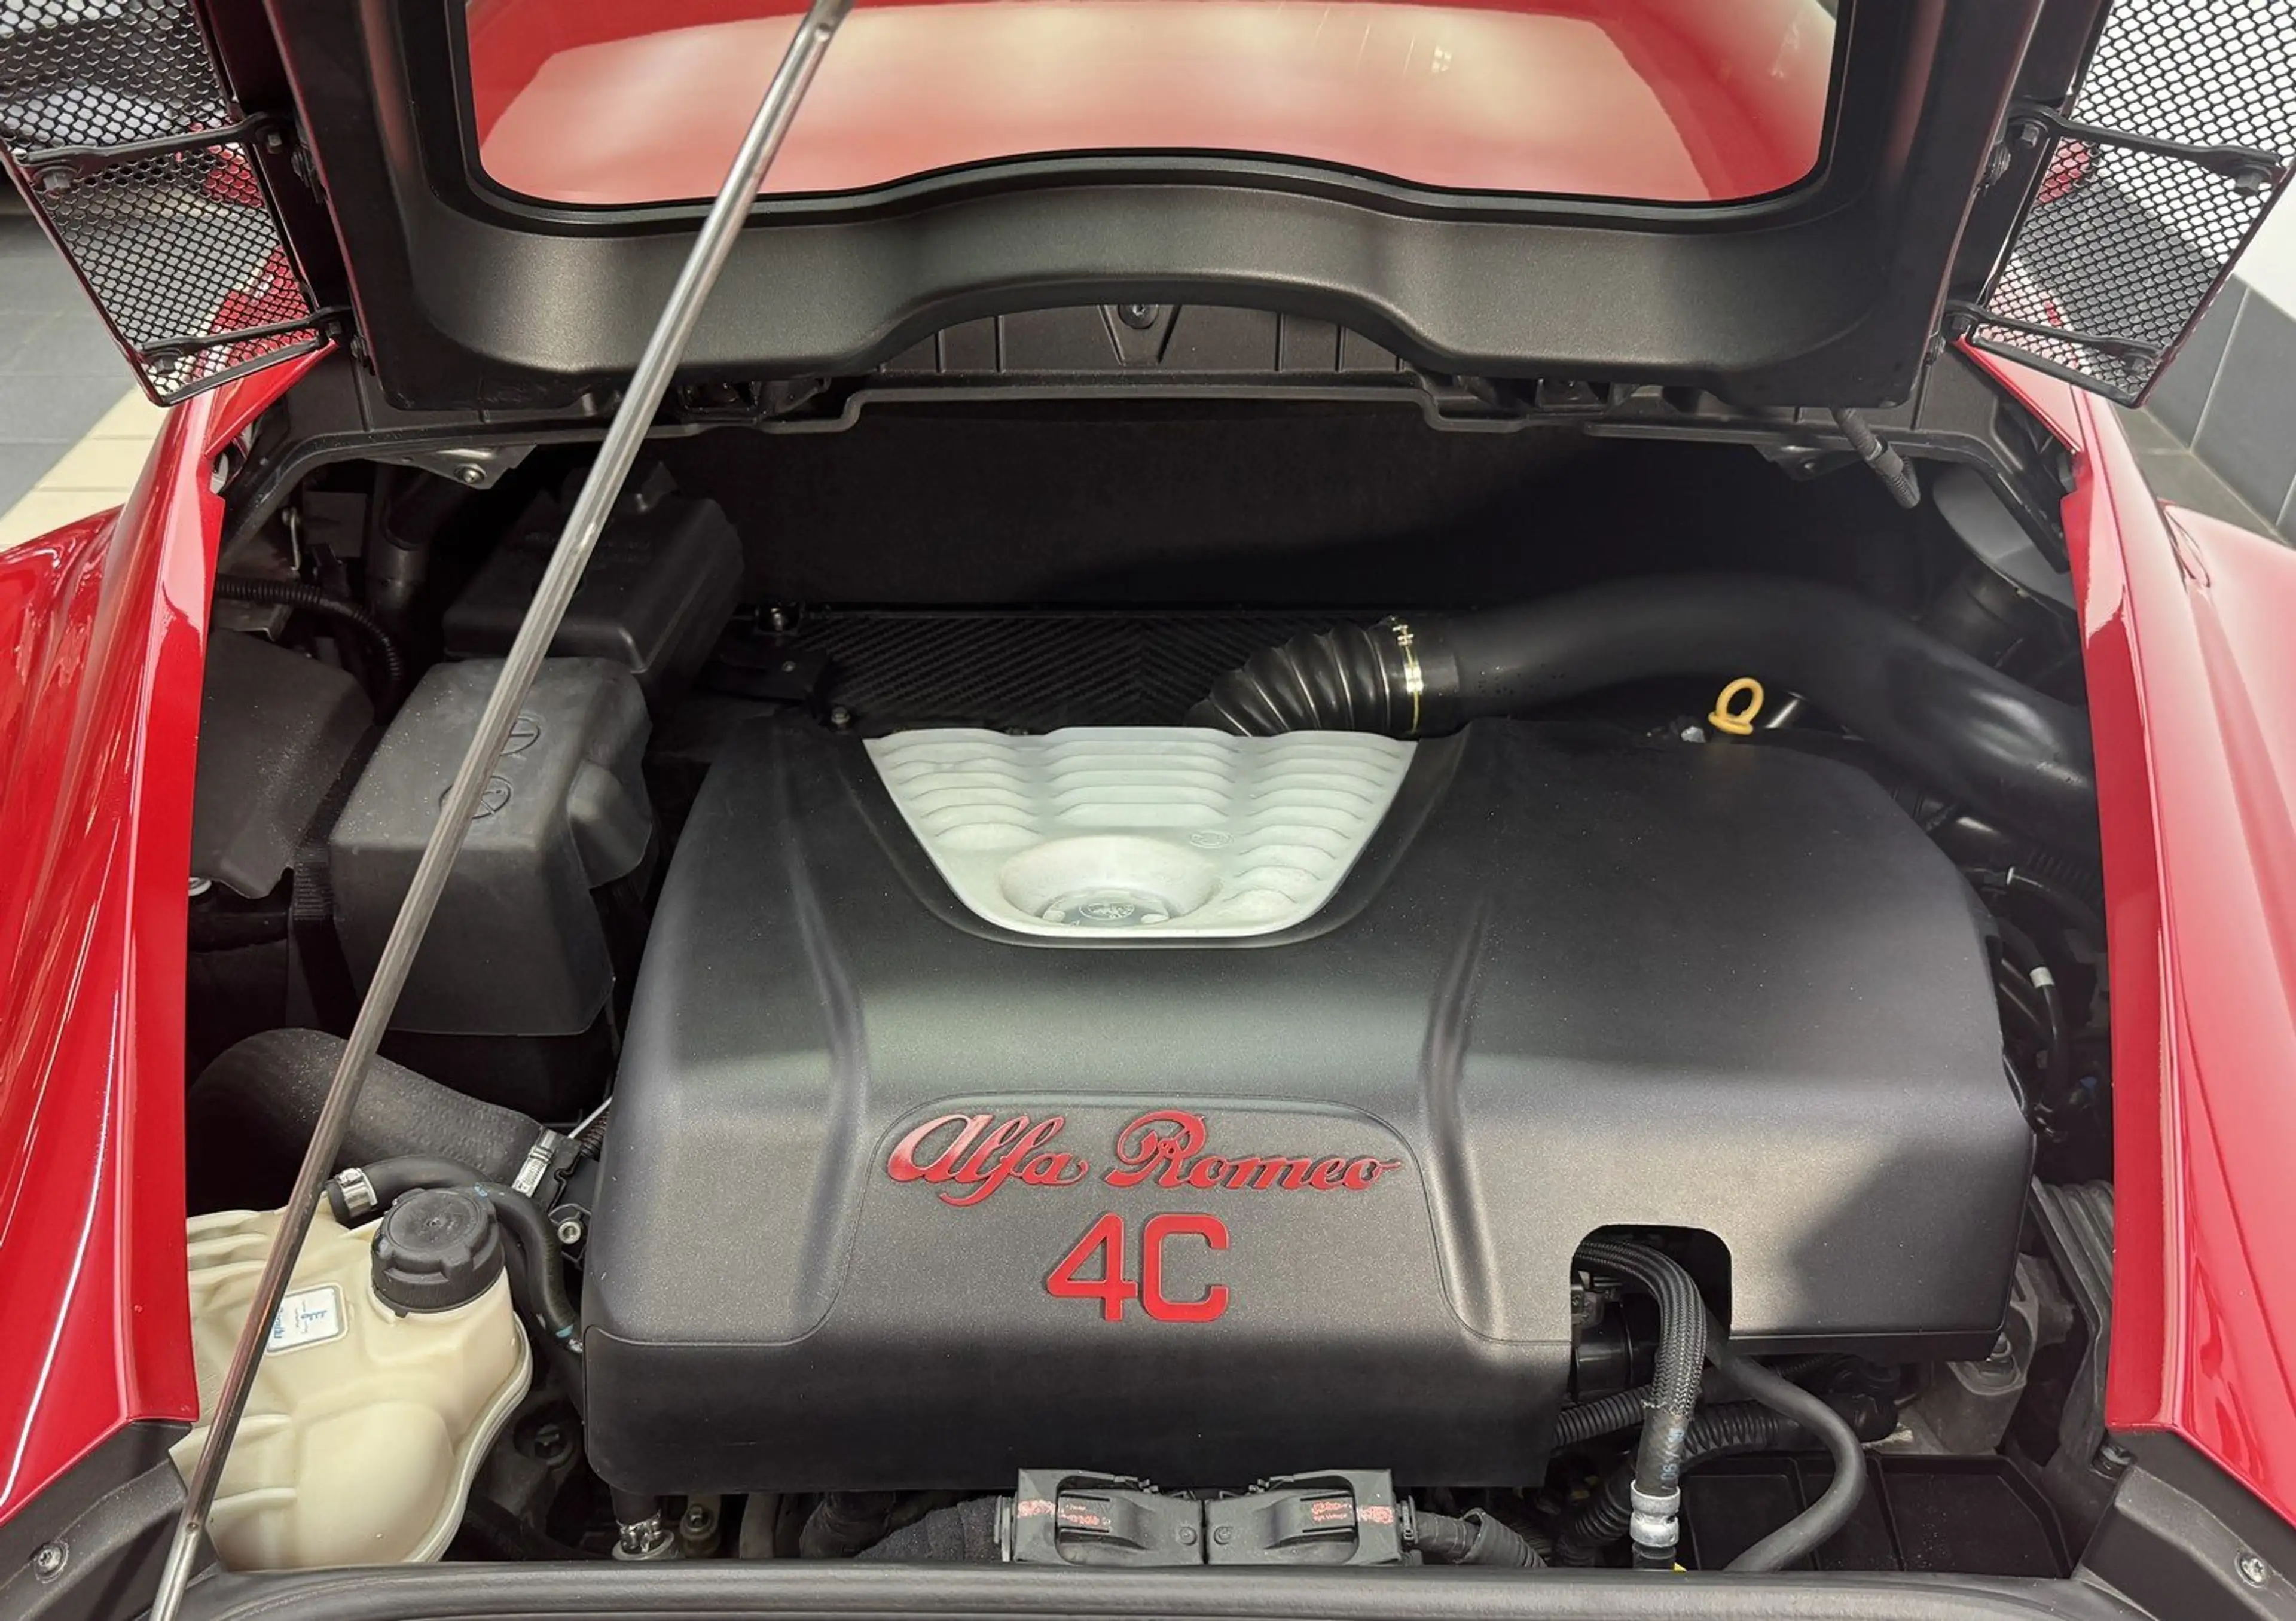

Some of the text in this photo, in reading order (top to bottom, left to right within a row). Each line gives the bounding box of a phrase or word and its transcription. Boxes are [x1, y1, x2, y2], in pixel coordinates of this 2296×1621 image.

[887, 1109, 1402, 1207] Alfa Romeo
[1047, 1212, 1230, 1321] 4C
